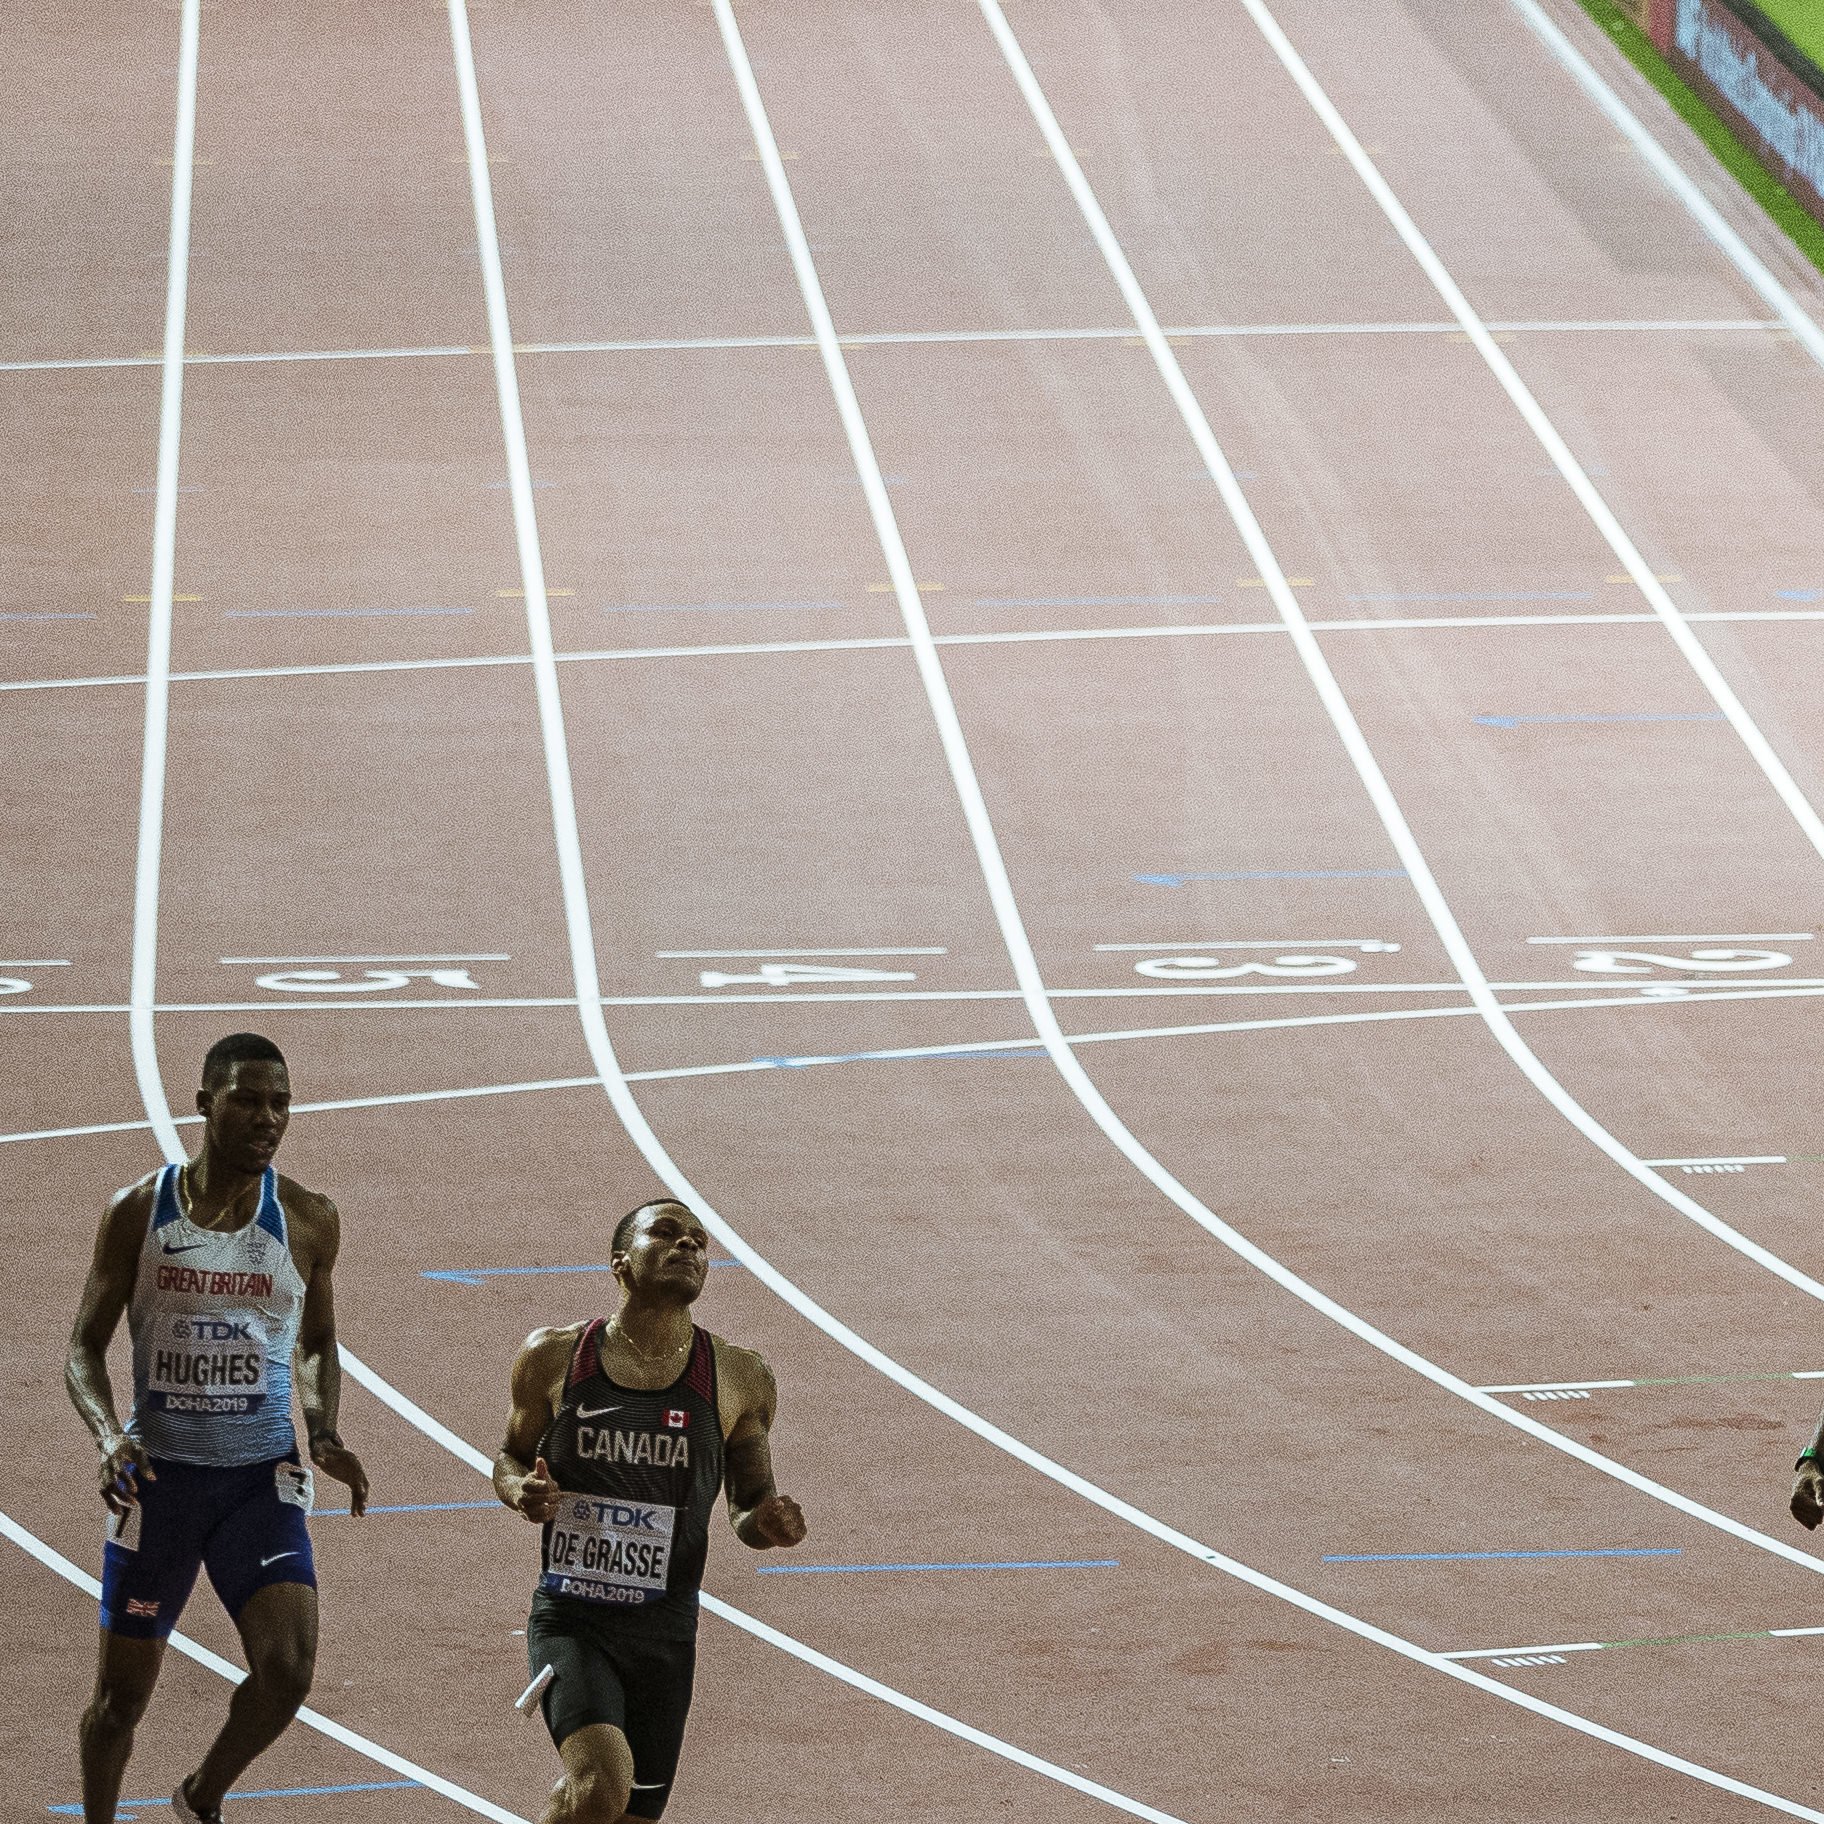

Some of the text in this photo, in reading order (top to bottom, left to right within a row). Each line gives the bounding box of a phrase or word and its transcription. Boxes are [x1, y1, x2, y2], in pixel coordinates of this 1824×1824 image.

[156, 1265, 274, 1298] GREAT BRITAIN
[192, 1321, 253, 1341] TDK
[155, 1349, 261, 1387] HUGHES
[577, 1426, 689, 1469] CANADA
[592, 1501, 657, 1531] TDK
[552, 1530, 667, 1580] DE GRASSE
